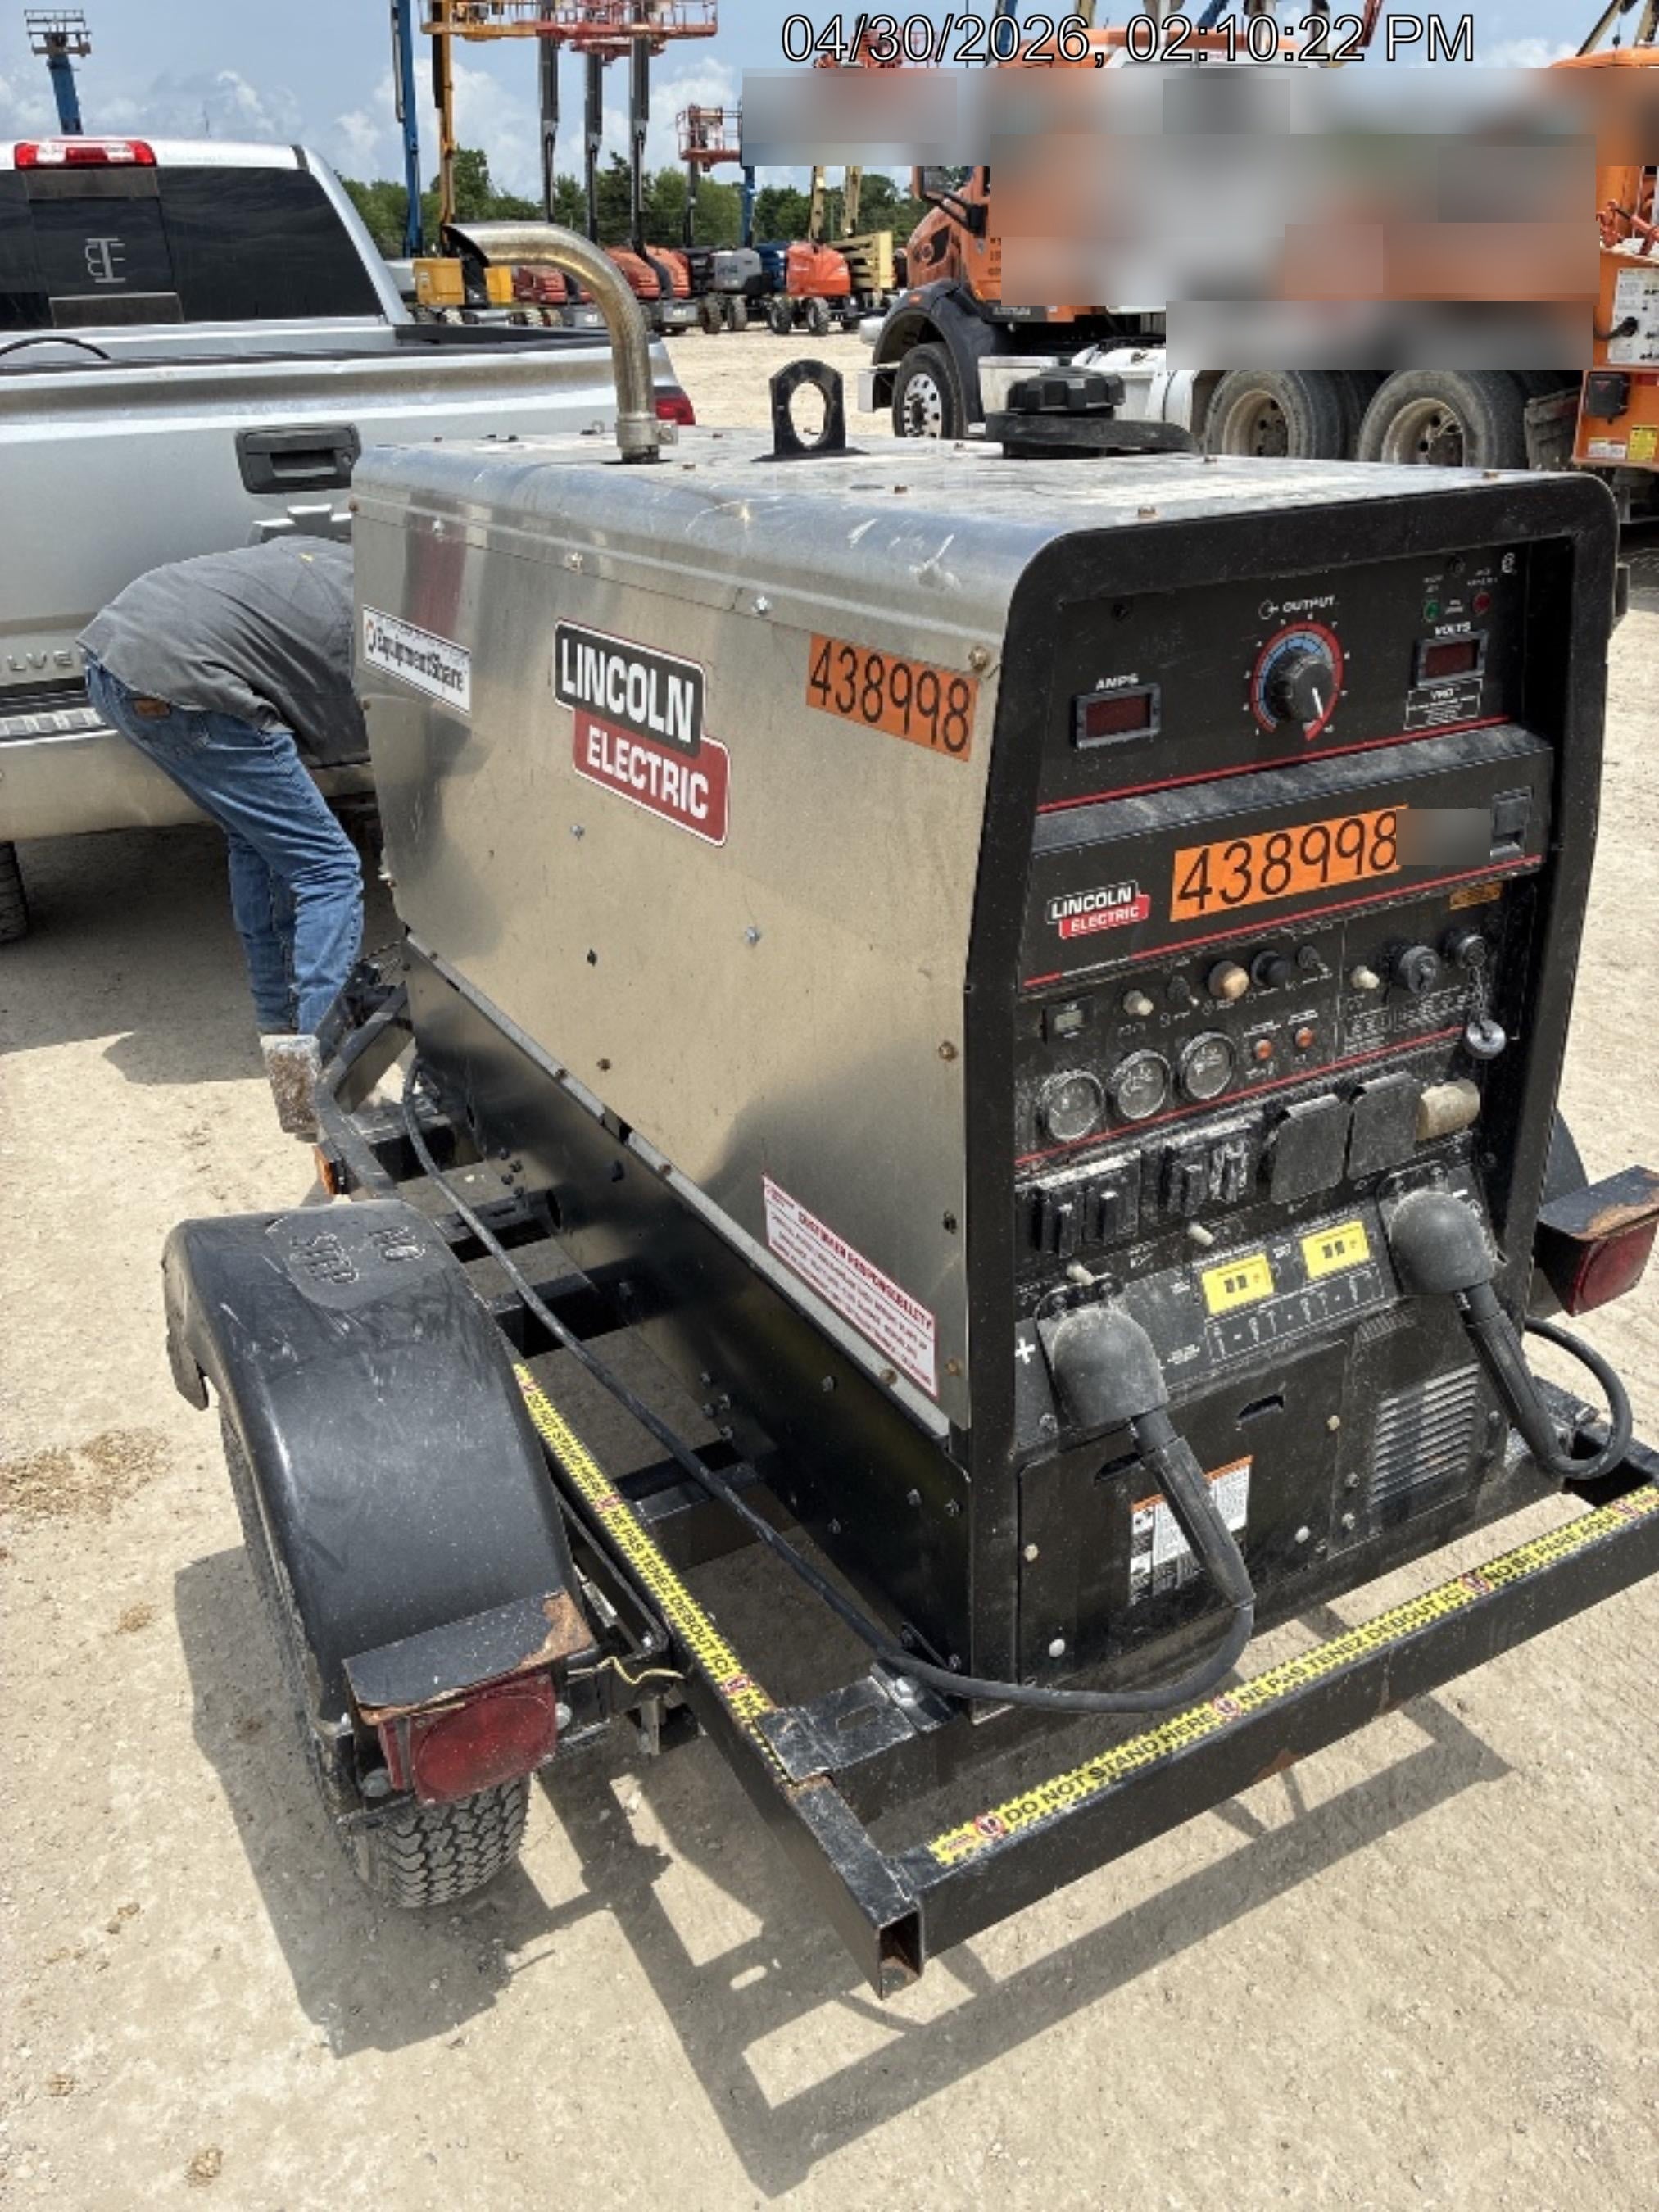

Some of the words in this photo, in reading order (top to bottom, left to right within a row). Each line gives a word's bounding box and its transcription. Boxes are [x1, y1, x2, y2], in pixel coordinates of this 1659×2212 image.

[1283, 595, 1335, 613] OUTPUT
[561, 638, 695, 744] LINCOLN
[810, 640, 971, 753] 438998
[1095, 673, 1139, 691] AMPS
[586, 724, 709, 820] ELECTRIC
[1177, 811, 1396, 910] 438998
[1051, 886, 1131, 919] LINCOLN
[1071, 906, 1140, 932] ELECTRIC
[669, 1597, 718, 1653] DEBOUT
[1004, 1801, 1039, 1823] DO
[1042, 1775, 1087, 1802] NOT
[1087, 1738, 1159, 1780] STAND
[1162, 1711, 1216, 1744] HERE
[1239, 1685, 1267, 1704] NE
[1268, 1665, 1307, 1689] PAS
[1307, 1636, 1365, 1669] TENEZ
[1365, 1598, 1439, 1639] DEBOUT
